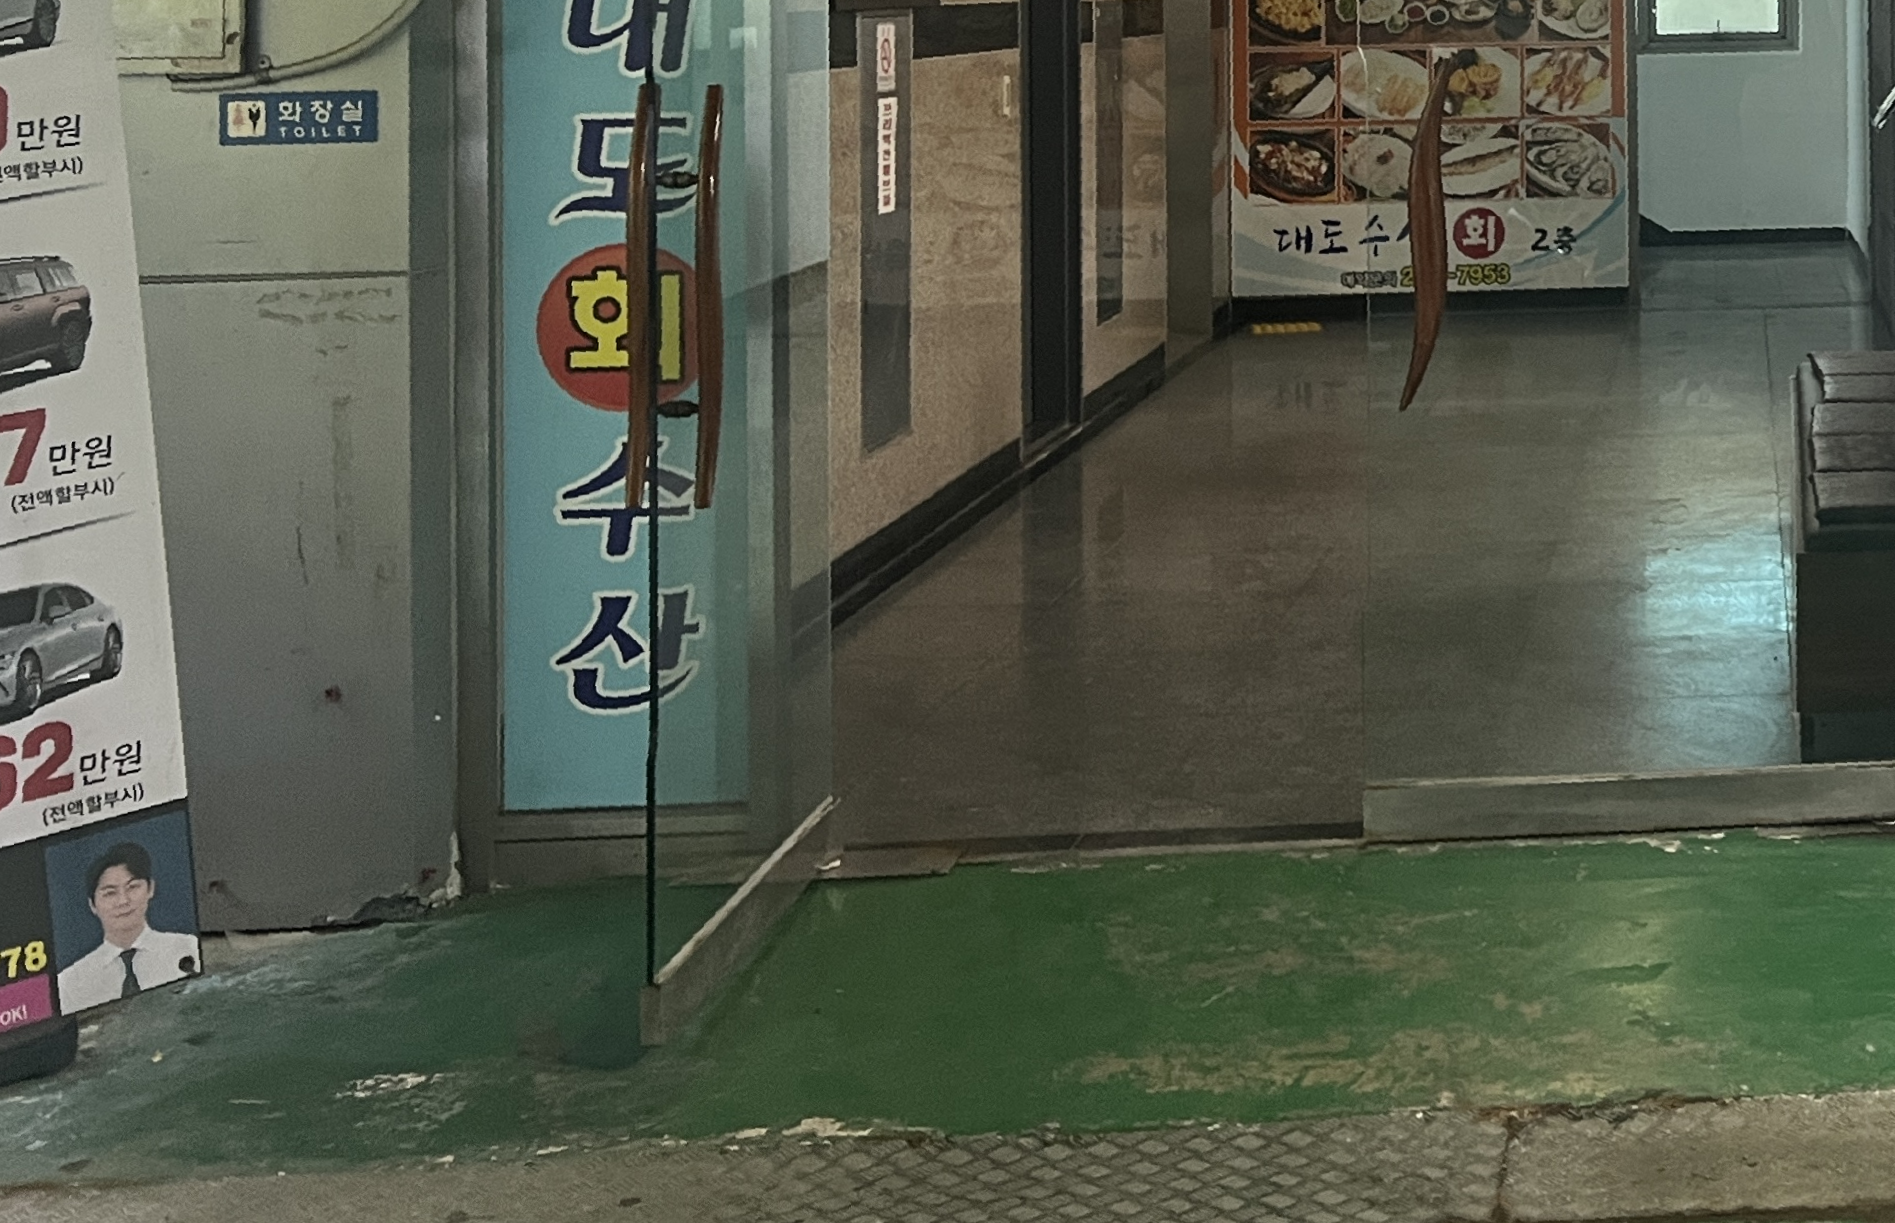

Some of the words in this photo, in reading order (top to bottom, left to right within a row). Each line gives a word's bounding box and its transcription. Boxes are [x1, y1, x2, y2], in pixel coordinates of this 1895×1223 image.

[279, 101, 362, 123] 화장실
[279, 126, 361, 138] TOILET
[0, 156, 83, 183] 액할부시)
[1274, 214, 1412, 258] 대도수
[1400, 264, 1511, 286] 2-7953
